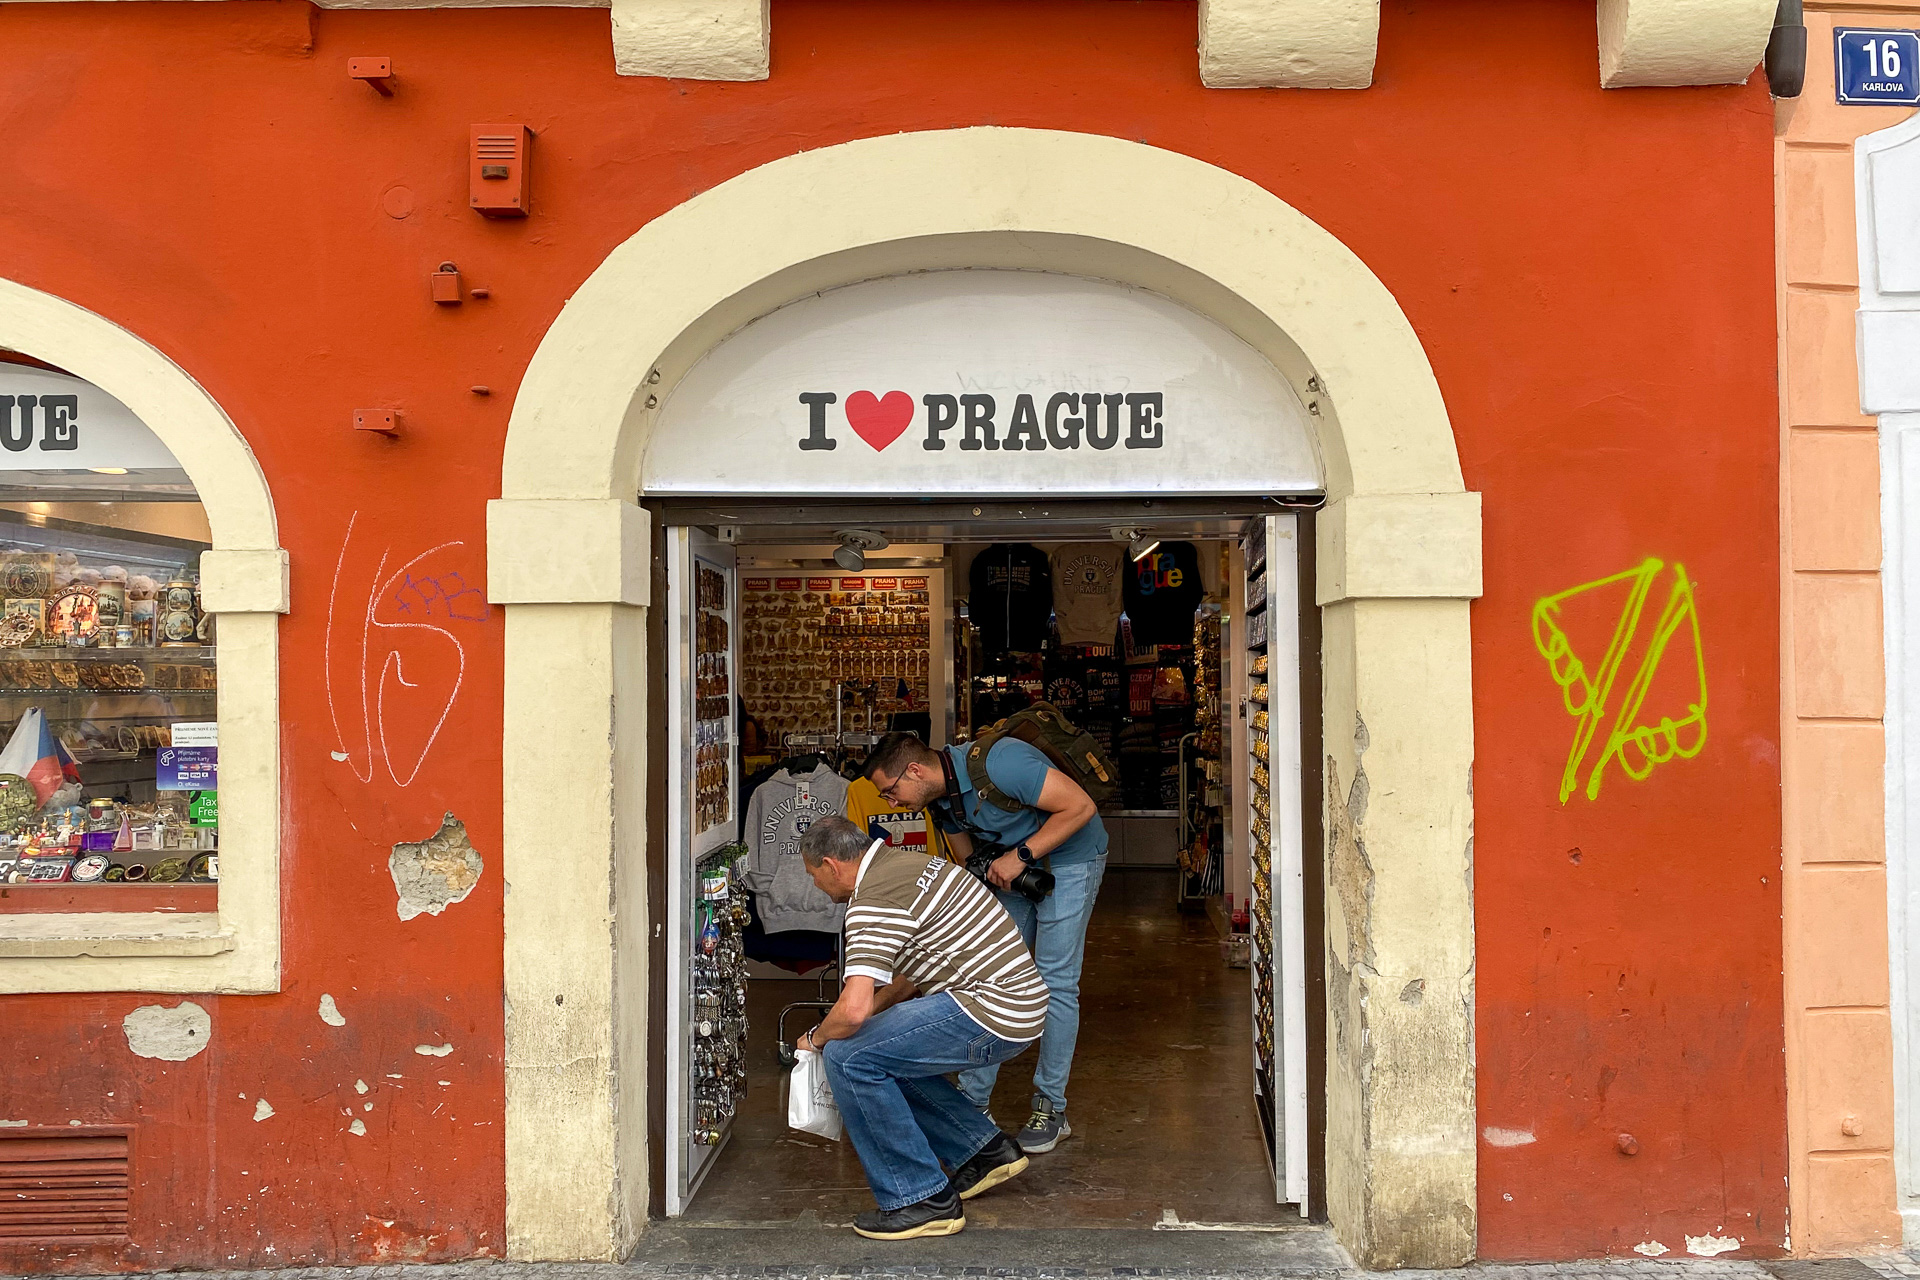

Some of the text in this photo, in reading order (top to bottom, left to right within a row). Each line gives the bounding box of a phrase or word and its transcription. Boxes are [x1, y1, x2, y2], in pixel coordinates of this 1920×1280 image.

[1862, 39, 1901, 78] 16
[1862, 82, 1904, 92] KARLOVA
[798, 391, 1163, 451] I PRAGUE
[1139, 567, 1184, 596] gue
[1073, 586, 1107, 594] PRAGUE
[201, 796, 217, 807] Tax
[198, 806, 218, 817] Free
[868, 811, 924, 824] PRAHA
